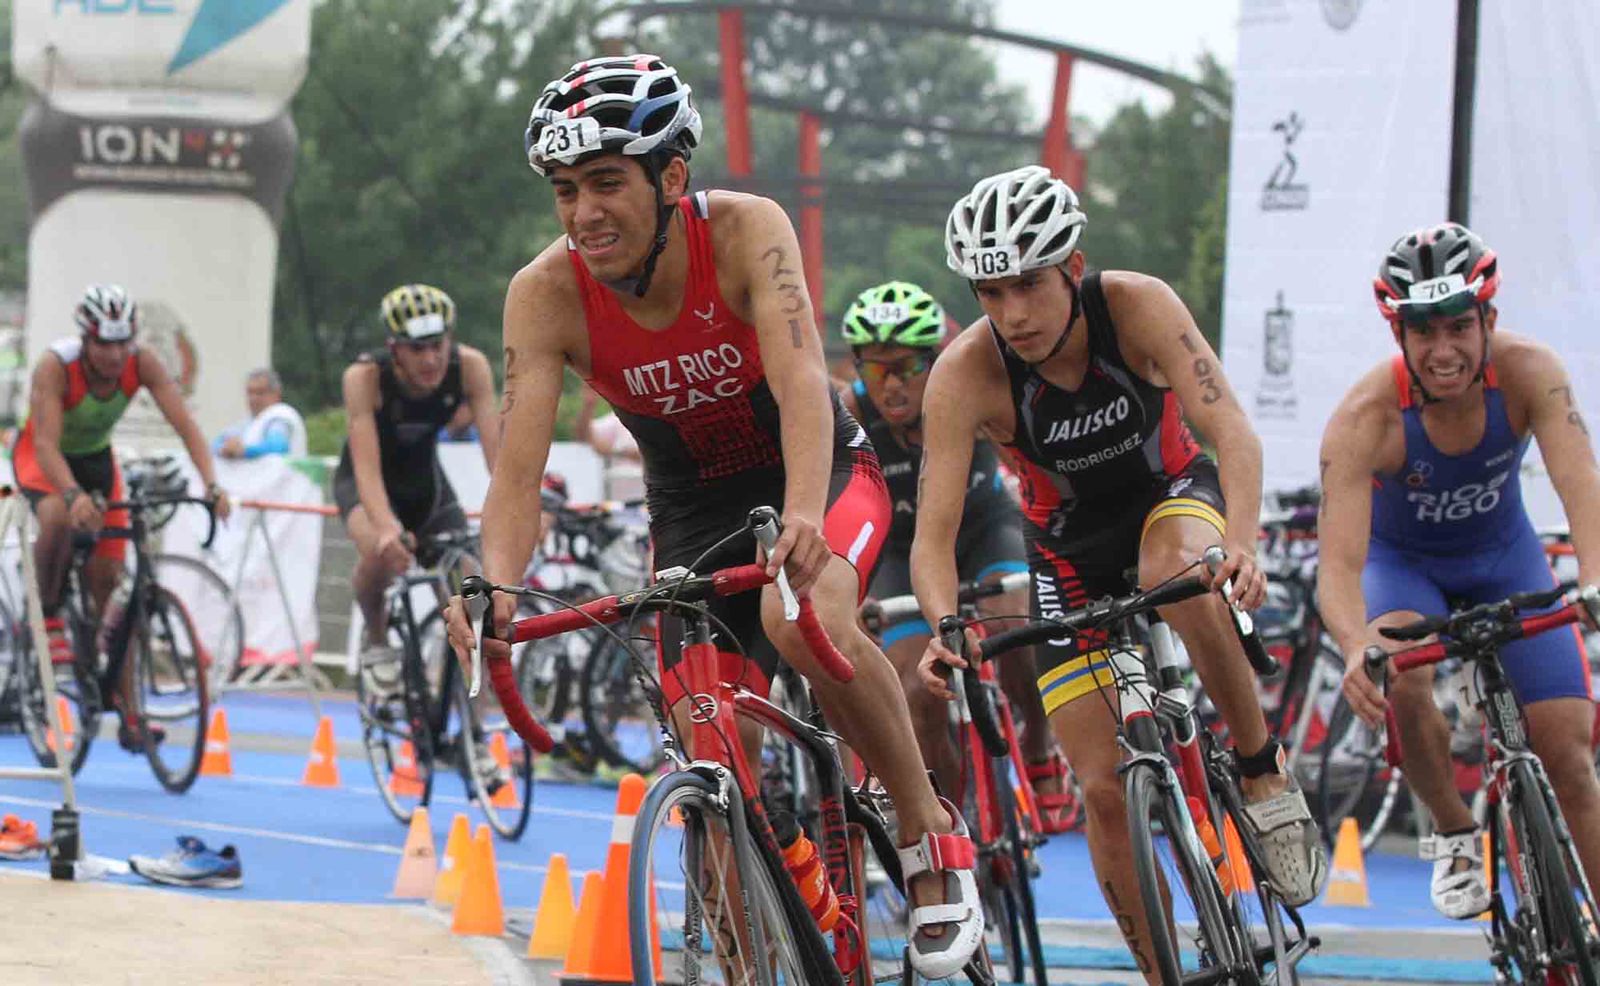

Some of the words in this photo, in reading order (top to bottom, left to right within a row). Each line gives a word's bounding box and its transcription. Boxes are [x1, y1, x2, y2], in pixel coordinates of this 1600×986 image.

[78, 125, 181, 163] ION
[545, 123, 587, 155] 231
[970, 250, 1010, 275] 103
[1423, 282, 1450, 300] 70
[622, 359, 681, 396] MTZ
[677, 343, 743, 384] RICO
[653, 377, 744, 415] ZAC
[1043, 395, 1130, 444] JALISCO
[1055, 431, 1144, 473] RODRIGUEZ
[1417, 489, 1501, 523] HGO
[1035, 572, 1073, 647] JALIS
